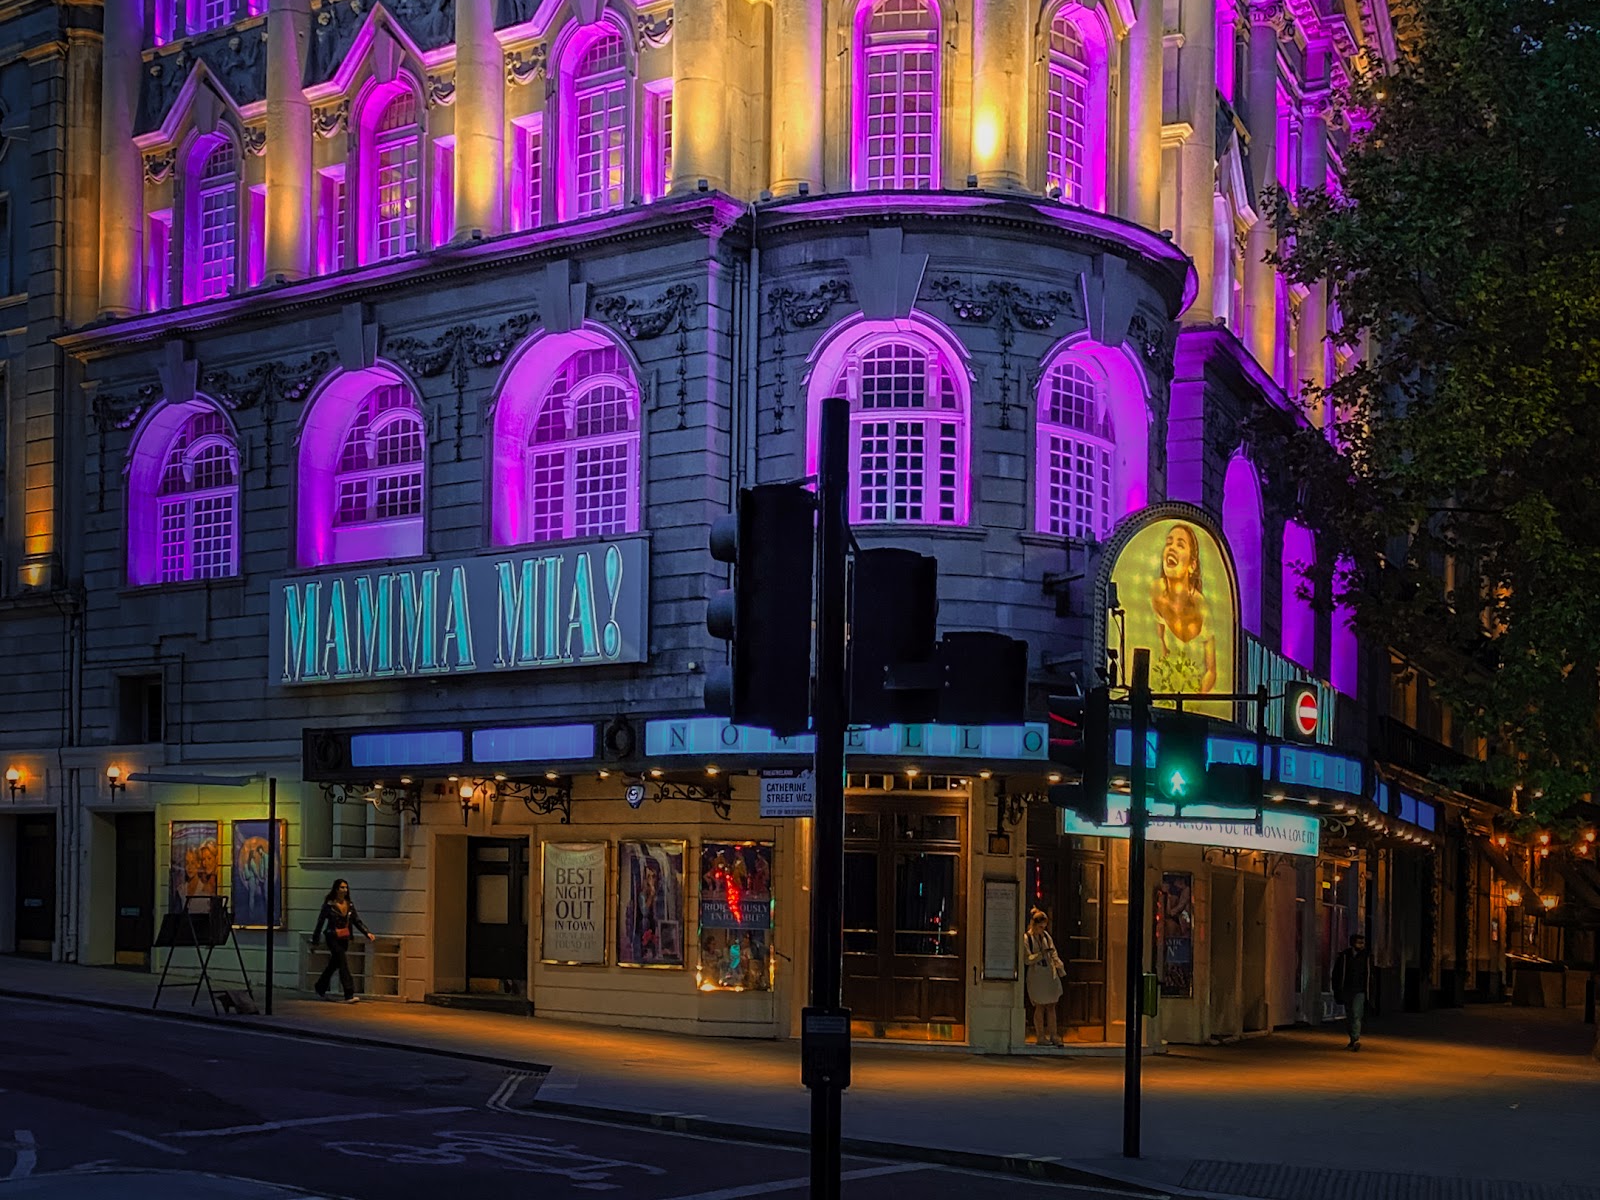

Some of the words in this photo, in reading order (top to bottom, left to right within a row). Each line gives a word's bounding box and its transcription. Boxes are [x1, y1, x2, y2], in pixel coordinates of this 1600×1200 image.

[281, 565, 477, 682] MAMMA
[493, 543, 624, 669] MIA!
[766, 783, 806, 792] CATHERINE
[766, 793, 794, 803] STREET
[796, 793, 812, 803] WC2
[1288, 829, 1306, 843] LOVE
[555, 867, 595, 885] BEST
[555, 886, 594, 899] NIGHT
[555, 900, 595, 920] OUT
[554, 921, 565, 930] IN
[567, 921, 596, 931] TOWN
